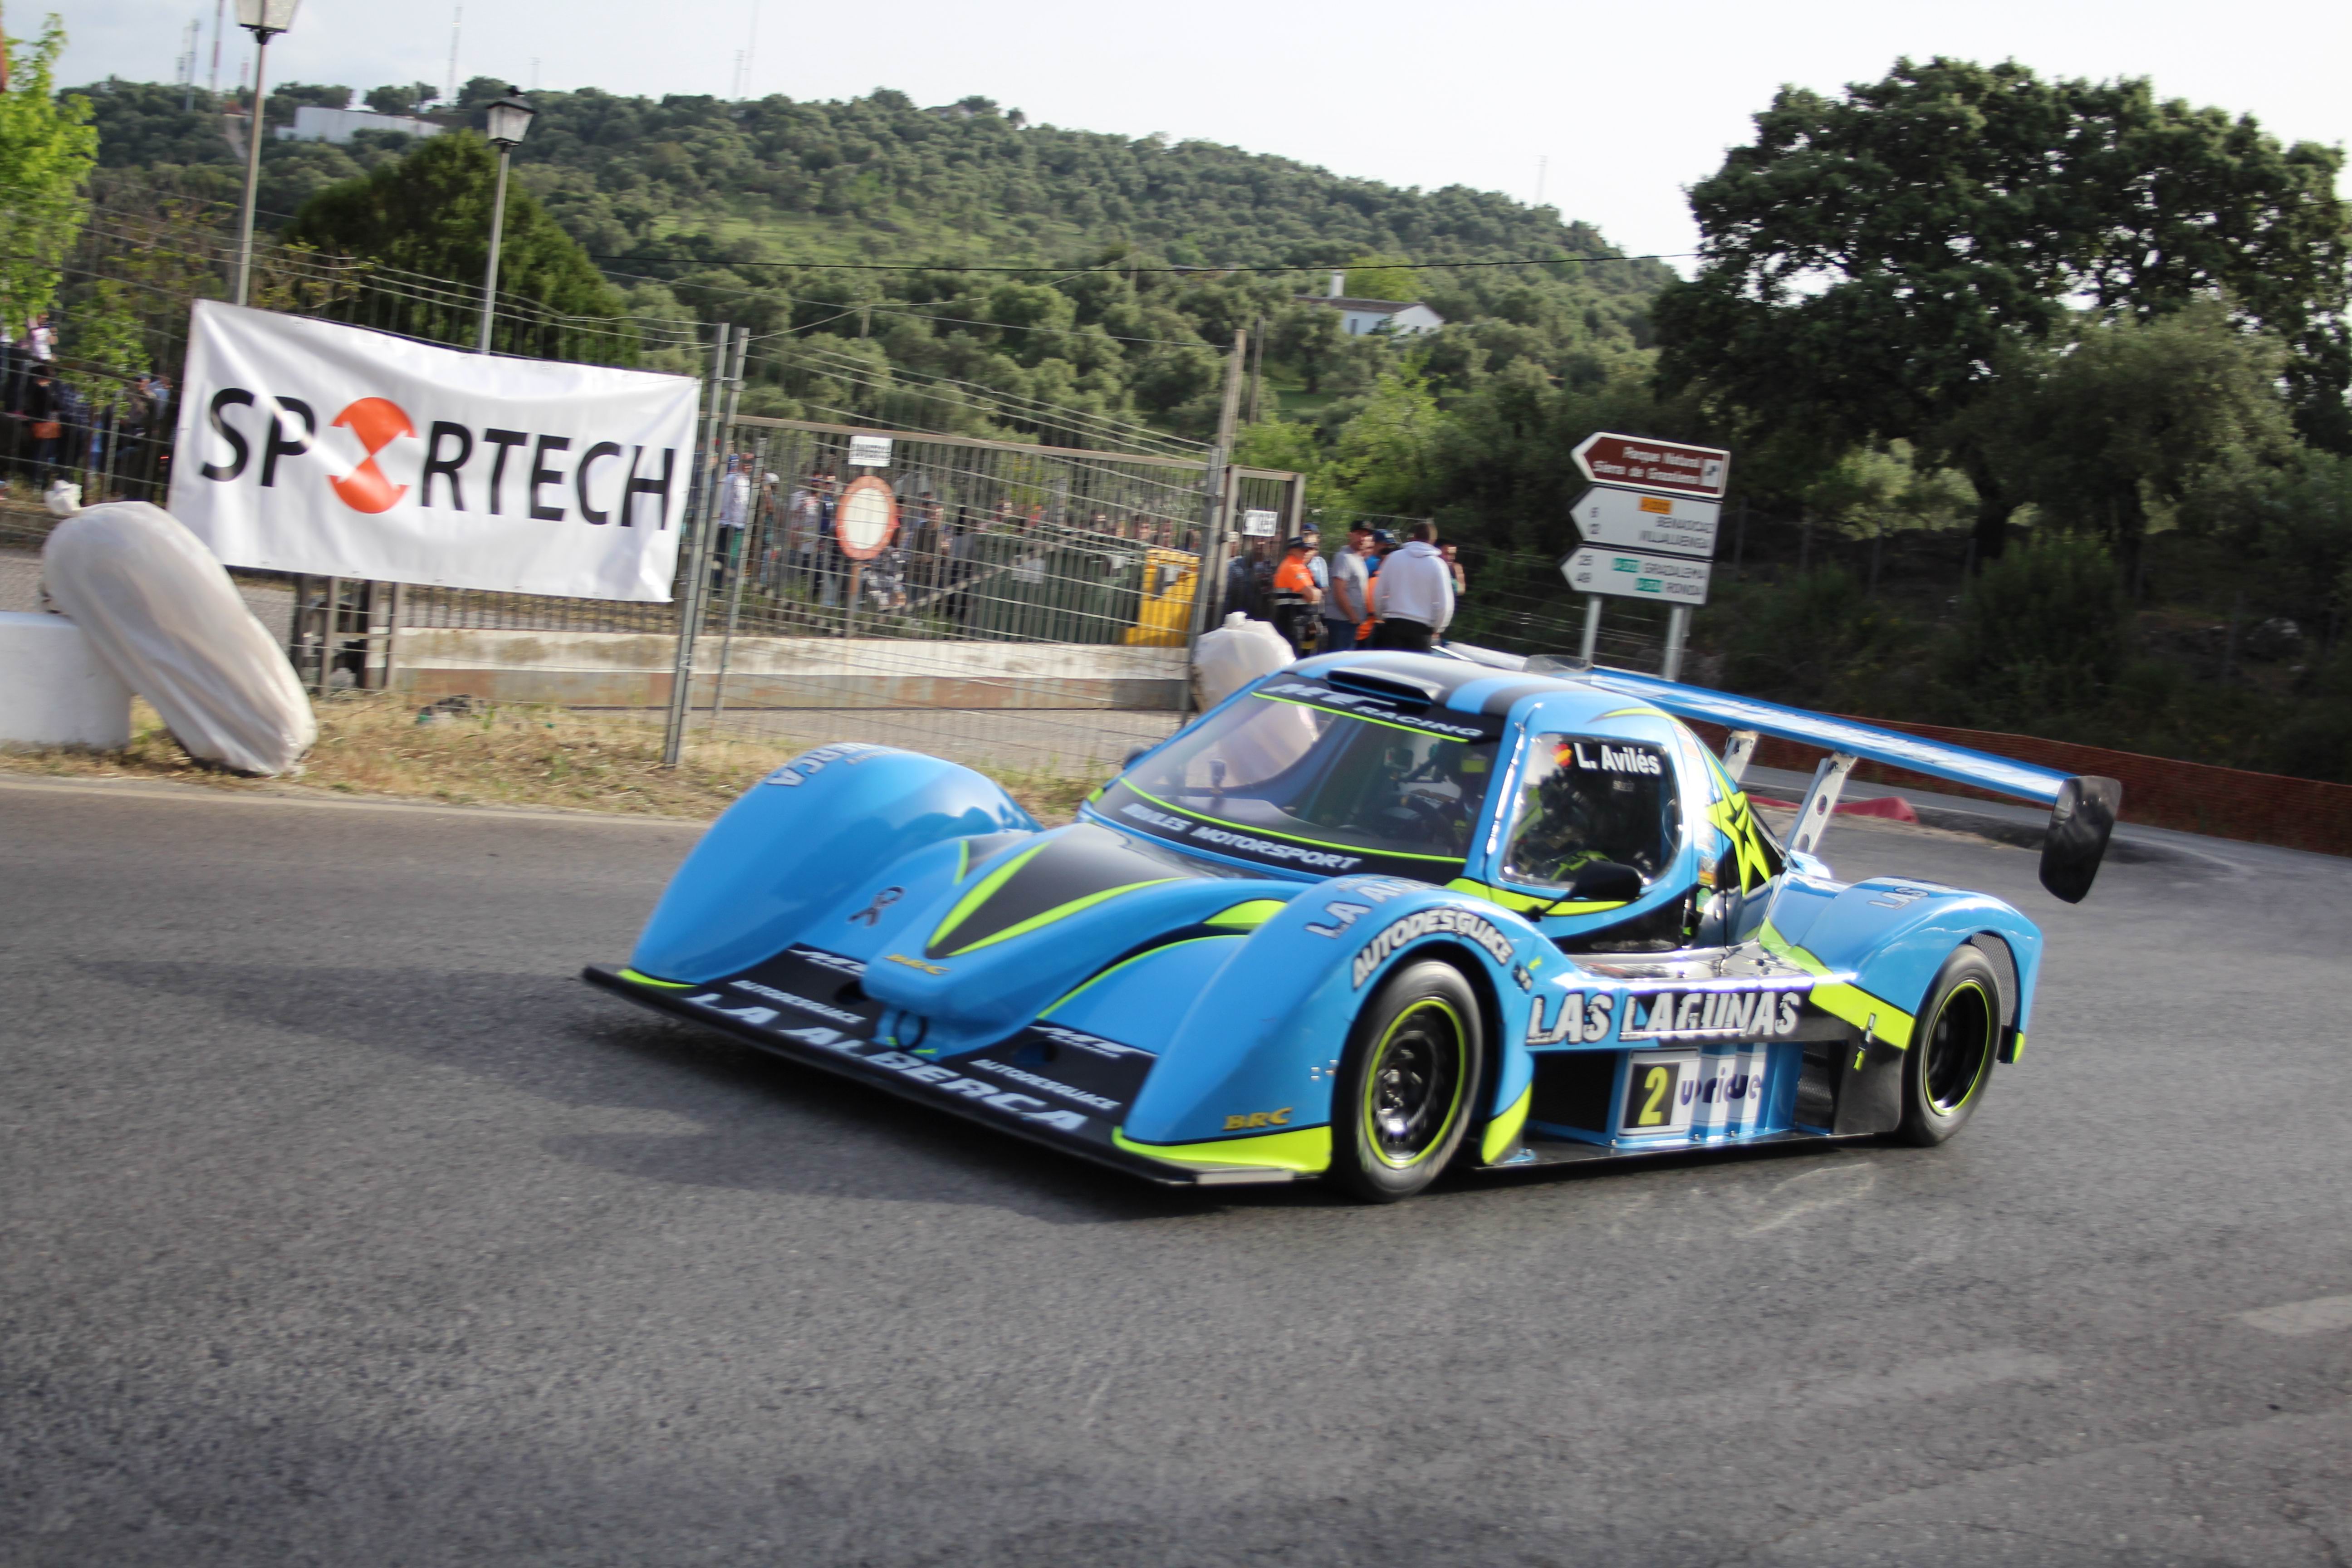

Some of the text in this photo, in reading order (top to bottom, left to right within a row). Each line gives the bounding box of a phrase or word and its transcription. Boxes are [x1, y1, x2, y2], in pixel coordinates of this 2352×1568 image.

[1352, 706, 1484, 736] RACING
[1573, 742, 1662, 775] L. Avilés
[1190, 826, 1362, 869] MOTORSPORT
[1303, 900, 1372, 939] LA
[1867, 887, 1929, 910] LAS
[1352, 906, 1515, 991] AUTODESGUACE
[728, 980, 867, 1024] AUTODESGUACE
[1525, 991, 1801, 1045] LAS LAGUNAS
[686, 993, 1088, 1130] LA ALBERCA
[968, 1058, 1123, 1110] AUTODESGUACE
[1638, 1066, 1669, 1125] 2
[1222, 1107, 1294, 1131] BRC
